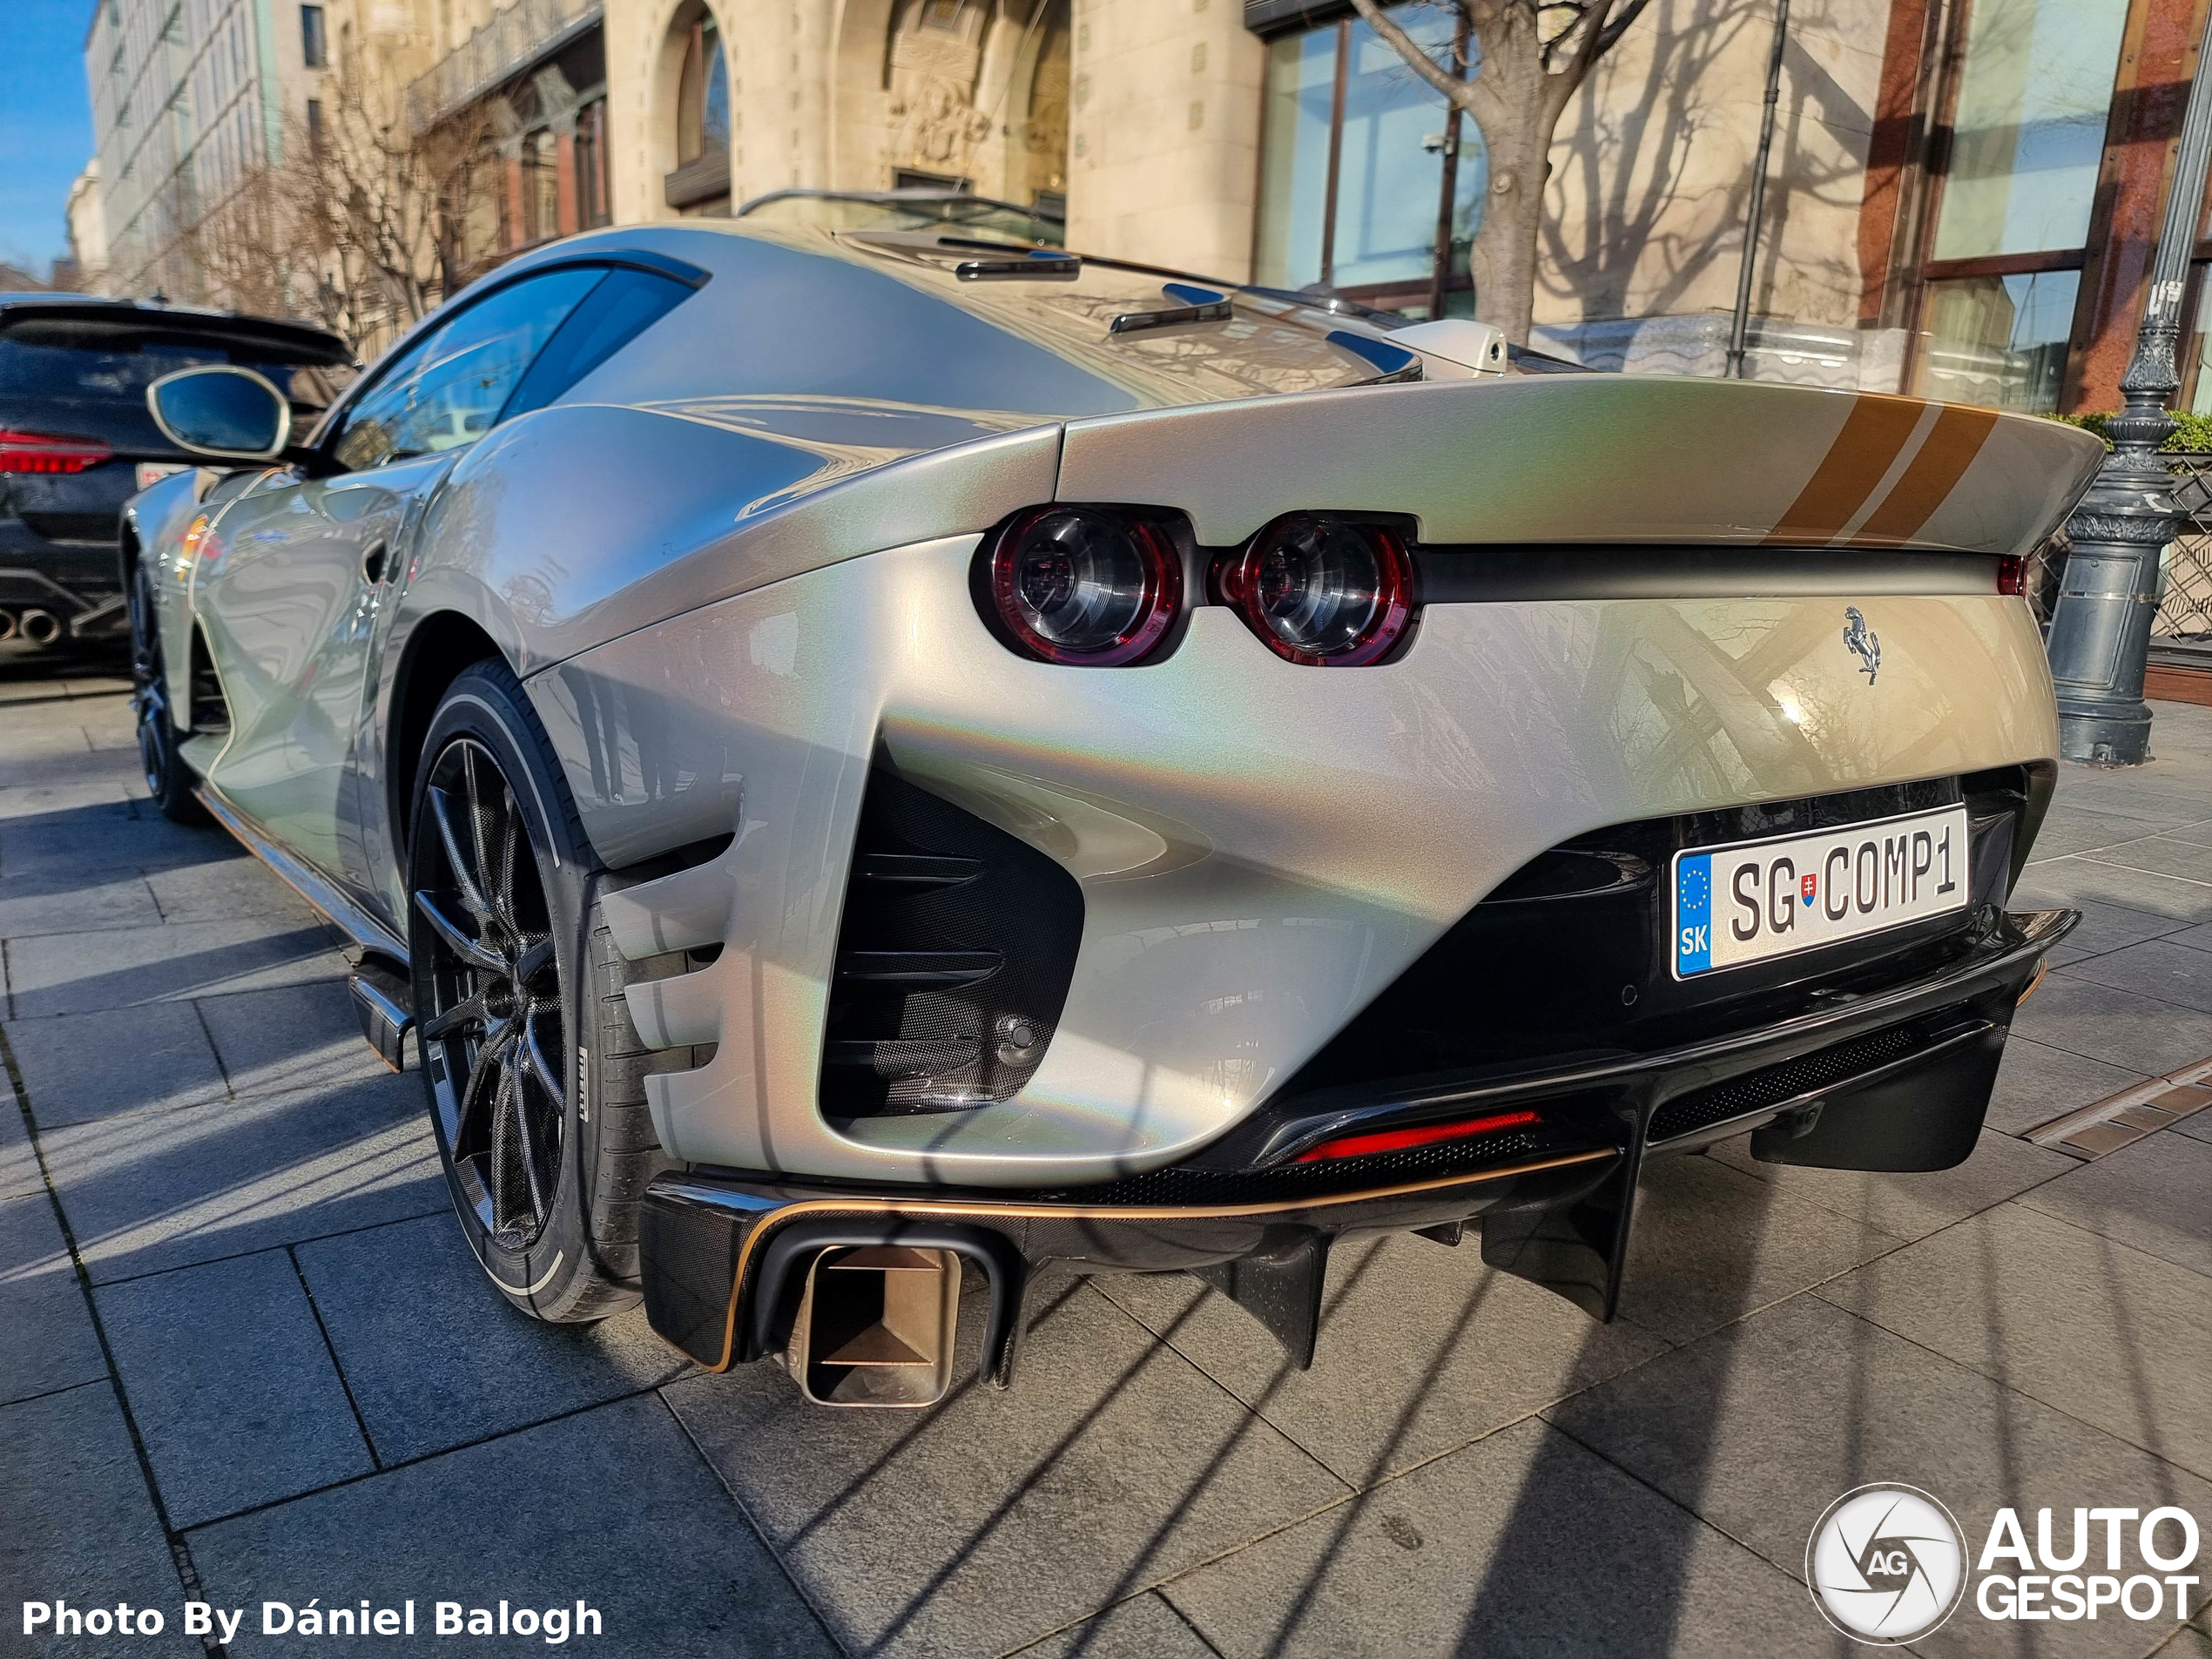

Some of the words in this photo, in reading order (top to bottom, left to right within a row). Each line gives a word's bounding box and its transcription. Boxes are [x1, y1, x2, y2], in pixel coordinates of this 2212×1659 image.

[1731, 857, 1795, 941] SG
[1824, 824, 1956, 921] COMP1
[1681, 925, 1708, 955] SK
[578, 1046, 589, 1123] PIRELLI
